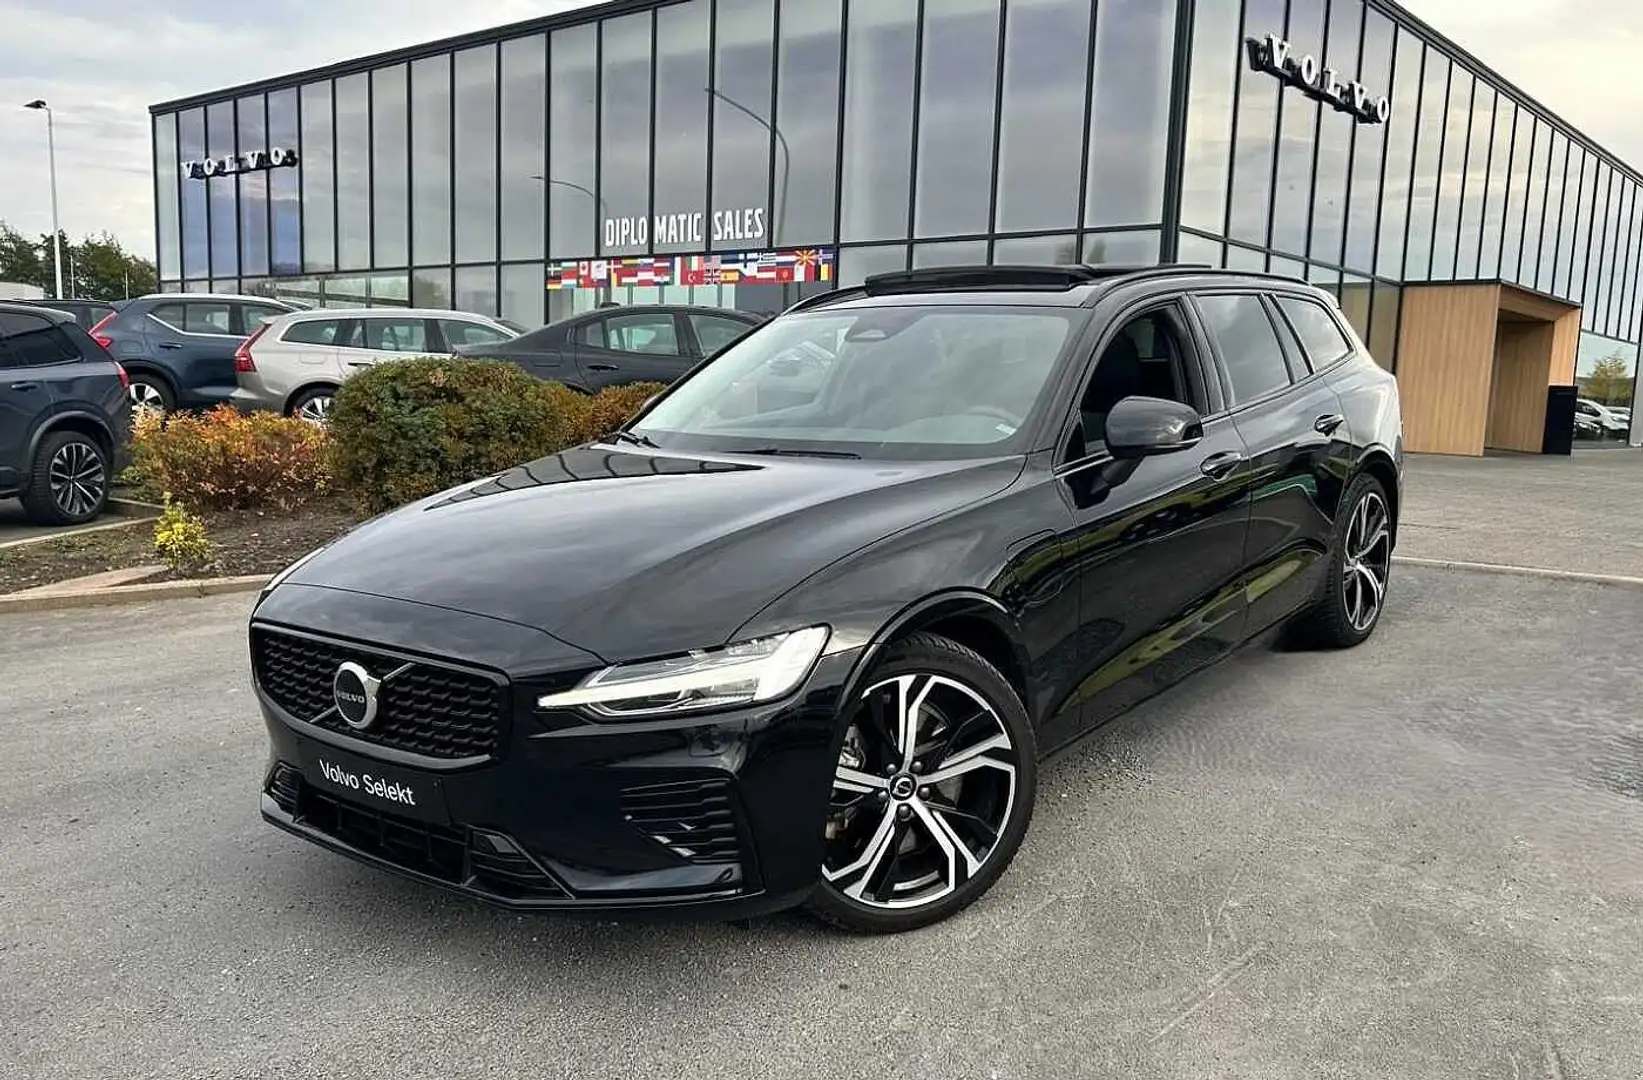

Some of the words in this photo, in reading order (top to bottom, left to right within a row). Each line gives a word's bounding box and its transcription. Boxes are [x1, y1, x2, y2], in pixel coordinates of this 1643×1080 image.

[1264, 33, 1390, 122] VOLVO
[181, 147, 287, 179] VOLVO
[713, 208, 764, 241] SALES
[319, 760, 360, 790] Volvo
[362, 773, 416, 806] Selekt
